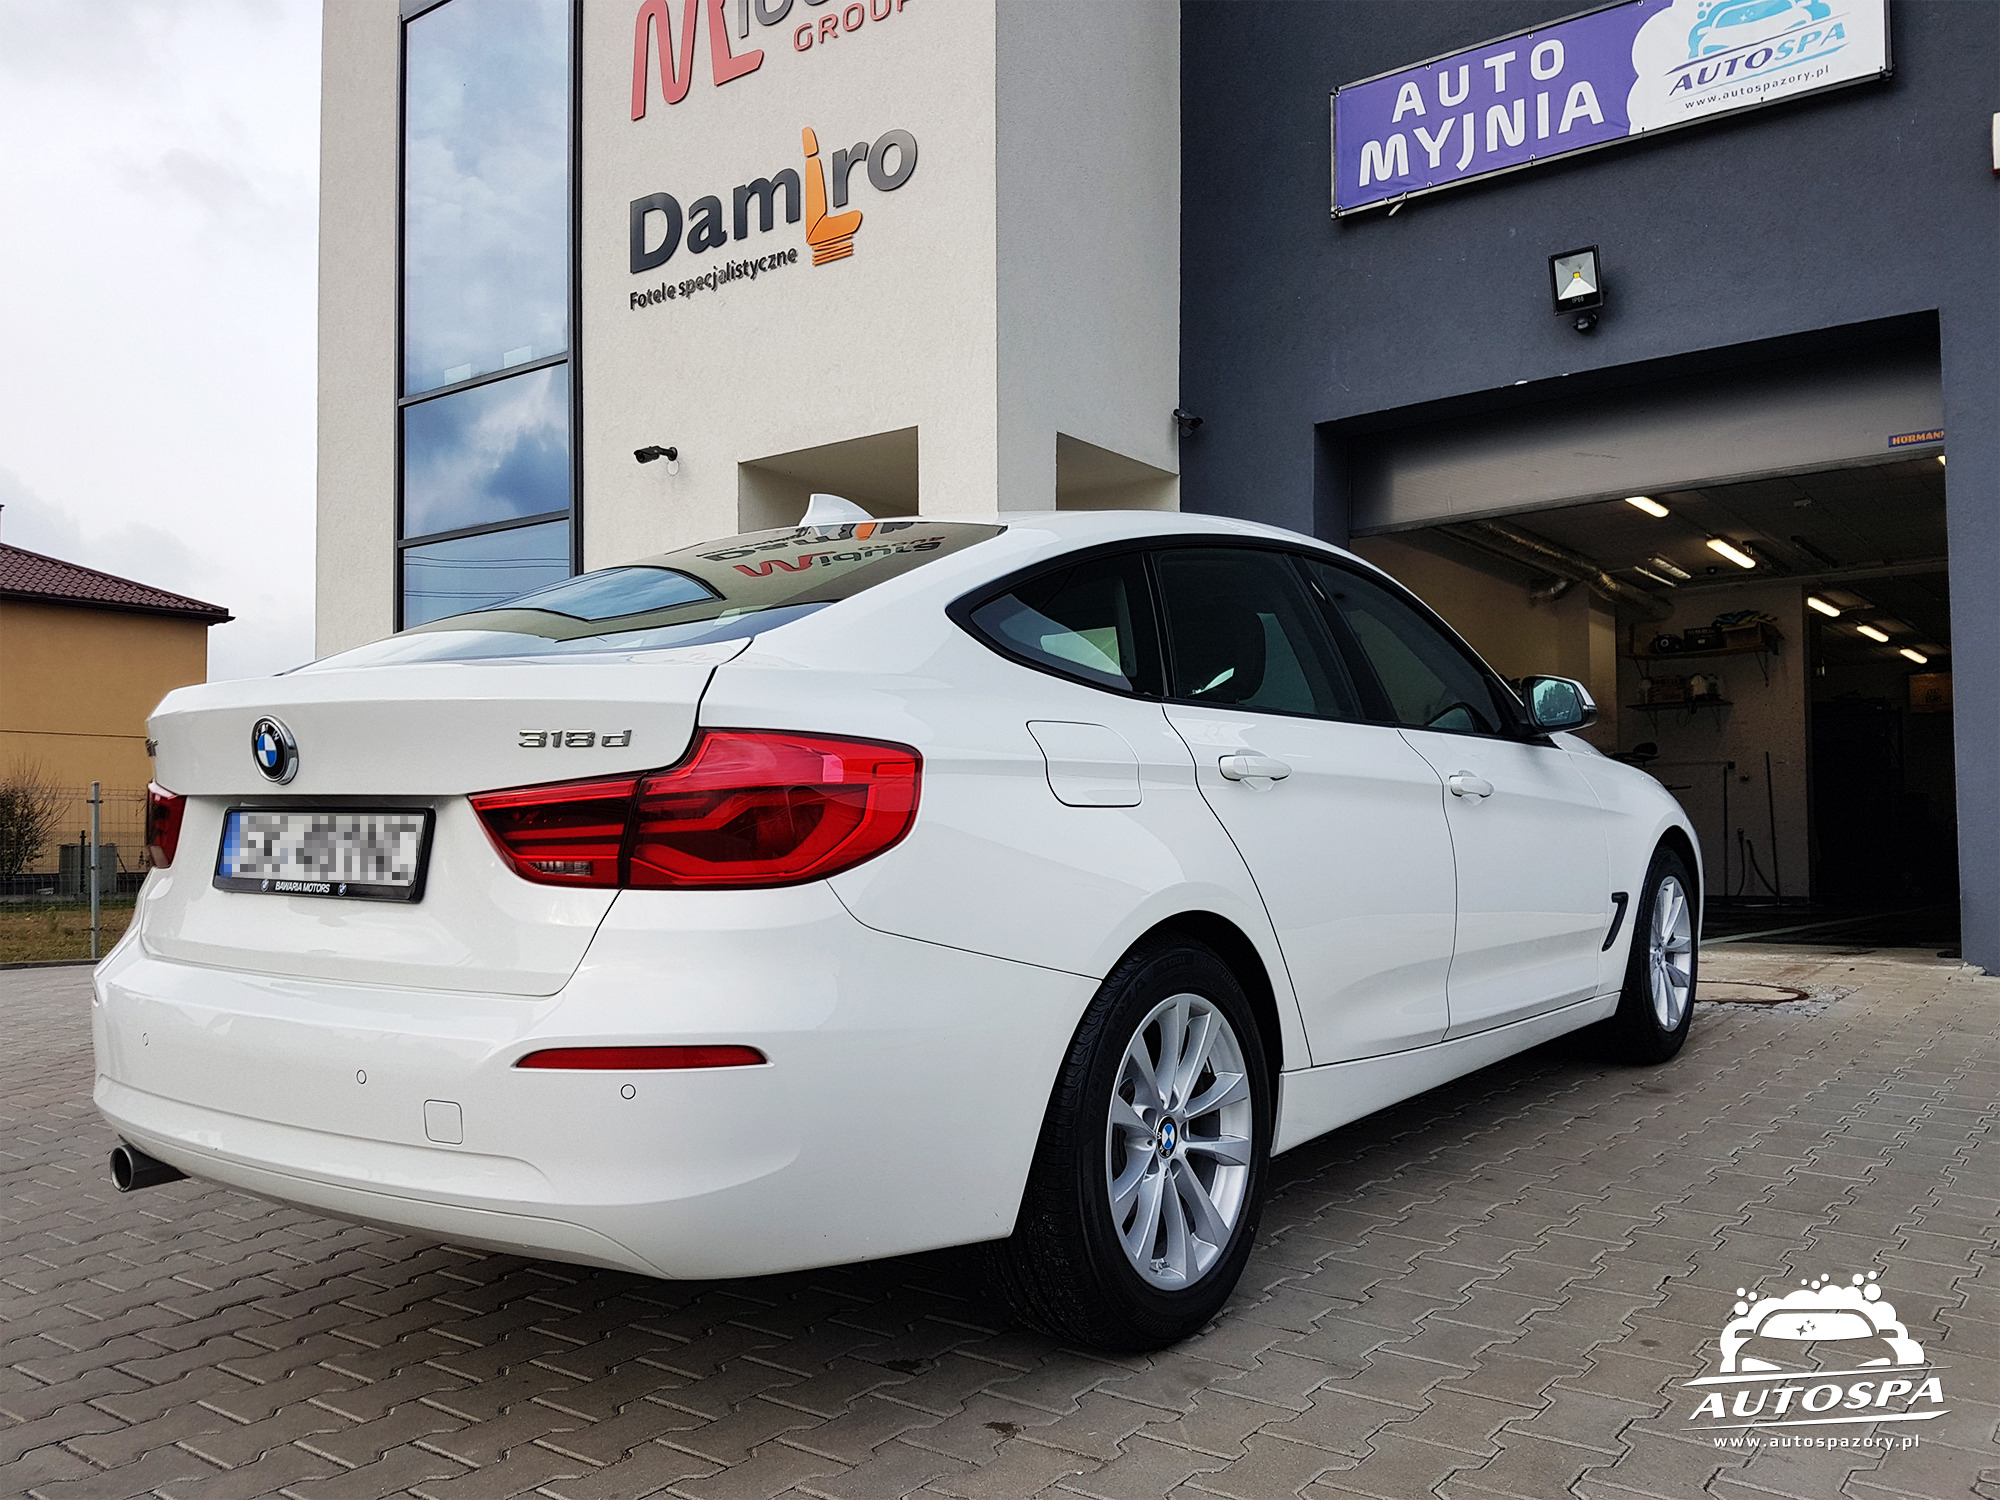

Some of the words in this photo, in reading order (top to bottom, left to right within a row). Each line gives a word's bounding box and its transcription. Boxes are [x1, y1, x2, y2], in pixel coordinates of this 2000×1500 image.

[1392, 39, 1565, 123] AUTO
[1669, 22, 1846, 96] AUTOSPA
[1685, 64, 1829, 109] www.autospazory.pl
[1359, 81, 1605, 187] MYJNIA
[630, 127, 918, 273] Damiro
[629, 282, 676, 311] Fotele
[678, 247, 798, 299] specjalistyczne
[518, 729, 632, 748] 318d
[303, 882, 331, 894] MOTORS
